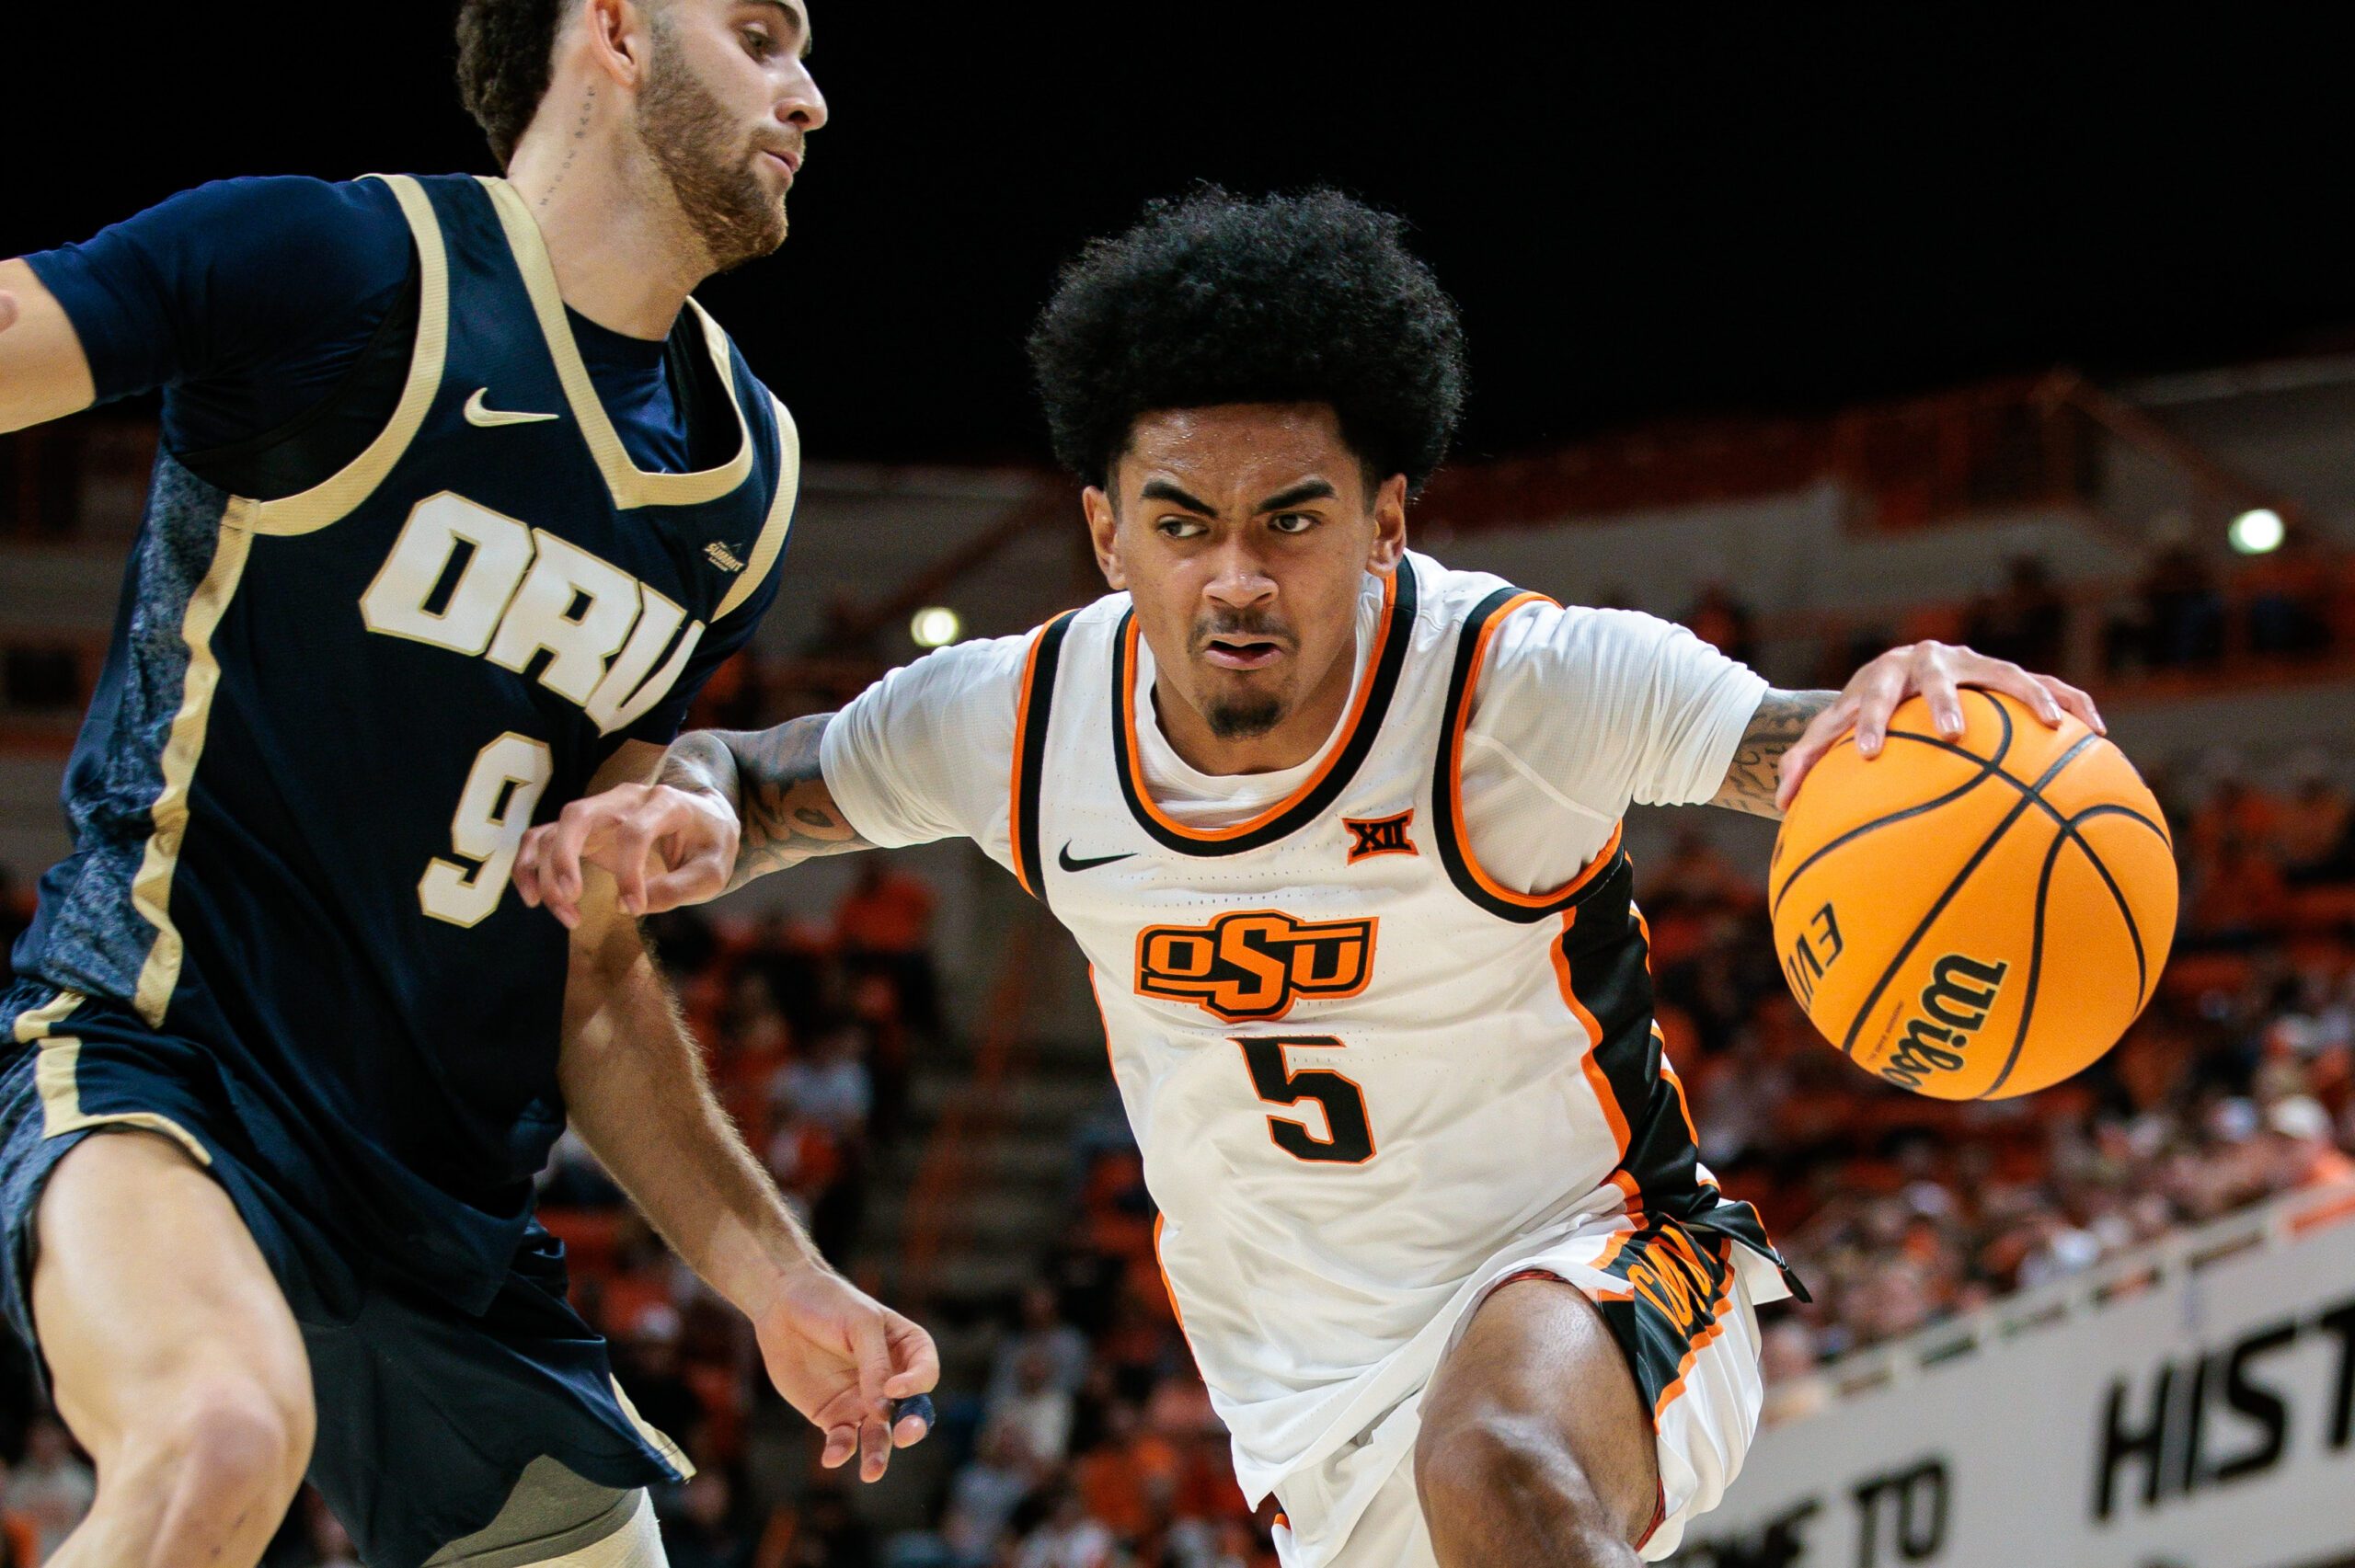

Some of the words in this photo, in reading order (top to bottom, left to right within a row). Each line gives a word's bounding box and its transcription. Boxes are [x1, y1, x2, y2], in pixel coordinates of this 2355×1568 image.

[359, 490, 706, 738] ORU
[418, 731, 552, 929] 9
[1346, 814, 1411, 859] XII
[1140, 913, 1373, 1020] OSU
[1881, 954, 2008, 1091] Wilso
[1225, 1036, 1376, 1164] 5
